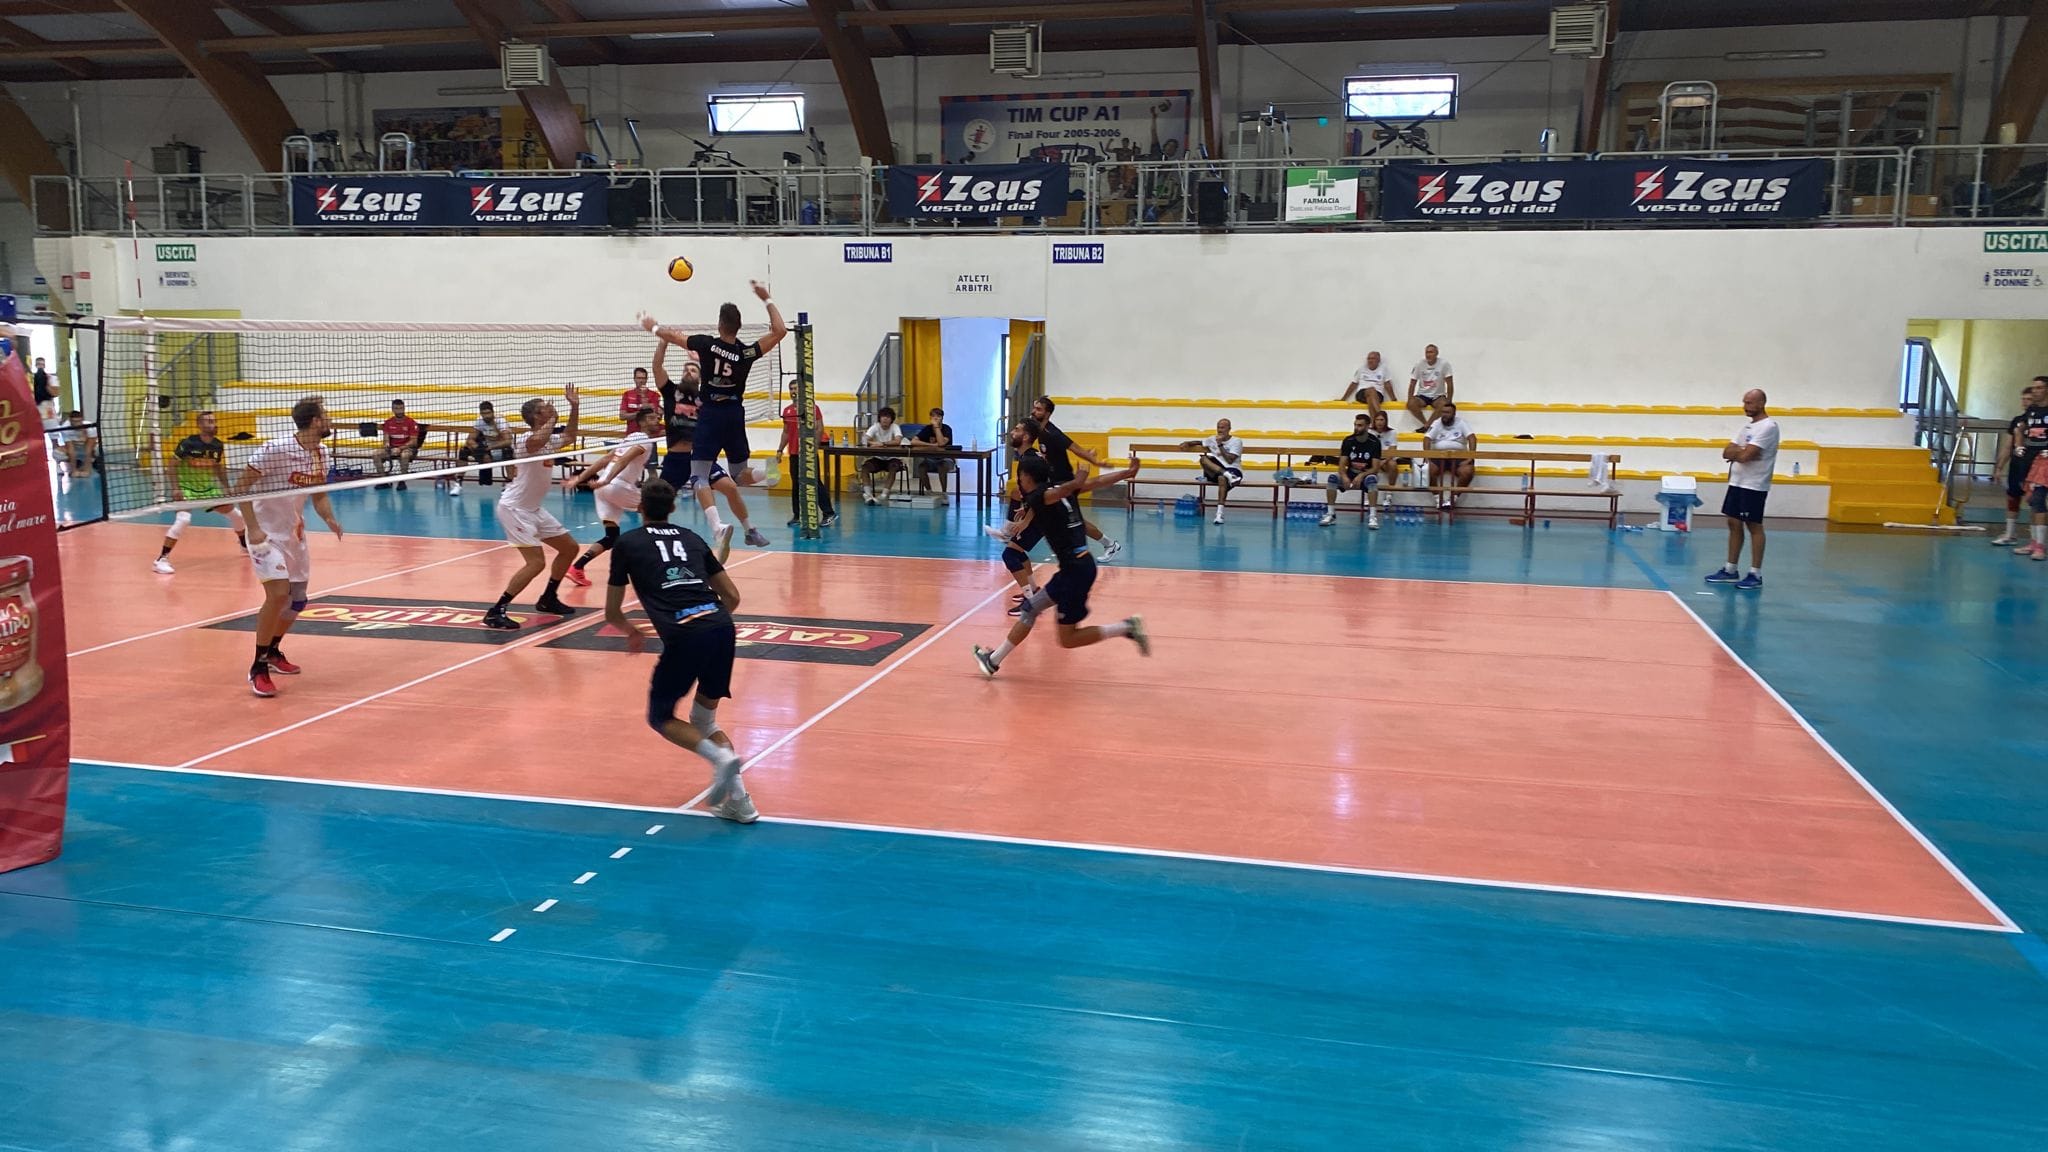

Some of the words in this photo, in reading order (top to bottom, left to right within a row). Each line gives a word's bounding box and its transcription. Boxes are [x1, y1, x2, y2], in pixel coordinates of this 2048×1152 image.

[1007, 108, 1042, 123] TIM
[1050, 106, 1088, 122] CUP
[1094, 105, 1120, 121] A1
[1008, 130, 1034, 140] Final
[1036, 130, 1060, 139] Four
[1063, 128, 1121, 138] 2005-2006
[943, 175, 1042, 202] Zeus
[1447, 175, 1565, 203] Zeus
[1665, 171, 1789, 200] Zeus
[338, 187, 422, 212] Zeus
[495, 187, 584, 212] Zeus
[921, 203, 972, 213] veste
[978, 202, 1002, 213] gli
[1007, 201, 1036, 212] dei
[1637, 204, 1703, 213] veste
[1707, 203, 1738, 213] gli
[1742, 202, 1781, 212] dei
[1421, 206, 1483, 215] veste
[1488, 204, 1516, 215] gli
[1521, 203, 1556, 214] dei
[320, 213, 365, 222] veste
[368, 213, 389, 223] gli
[393, 212, 417, 221] dei
[476, 214, 523, 222] veste
[526, 213, 548, 223] gli
[552, 212, 578, 221] dei
[1986, 234, 2048, 250] USCITA
[157, 246, 195, 259] USCITA
[846, 246, 879, 259] TRIBUNA
[881, 246, 891, 259] B1
[1054, 247, 1090, 260] TRIBUNA
[1091, 247, 1103, 260] B2
[958, 275, 989, 283] ATLETI
[1993, 269, 2033, 277] SERVIZI
[955, 284, 993, 292] ARBITRI
[1994, 279, 2029, 287] DONNE
[804, 331, 814, 376] BANCA
[713, 358, 733, 377] 15
[805, 381, 816, 430] CREDEM
[805, 436, 816, 479] BANCA
[806, 484, 818, 530] CREDEM
[16, 514, 47, 530] mare
[655, 540, 688, 562] 14
